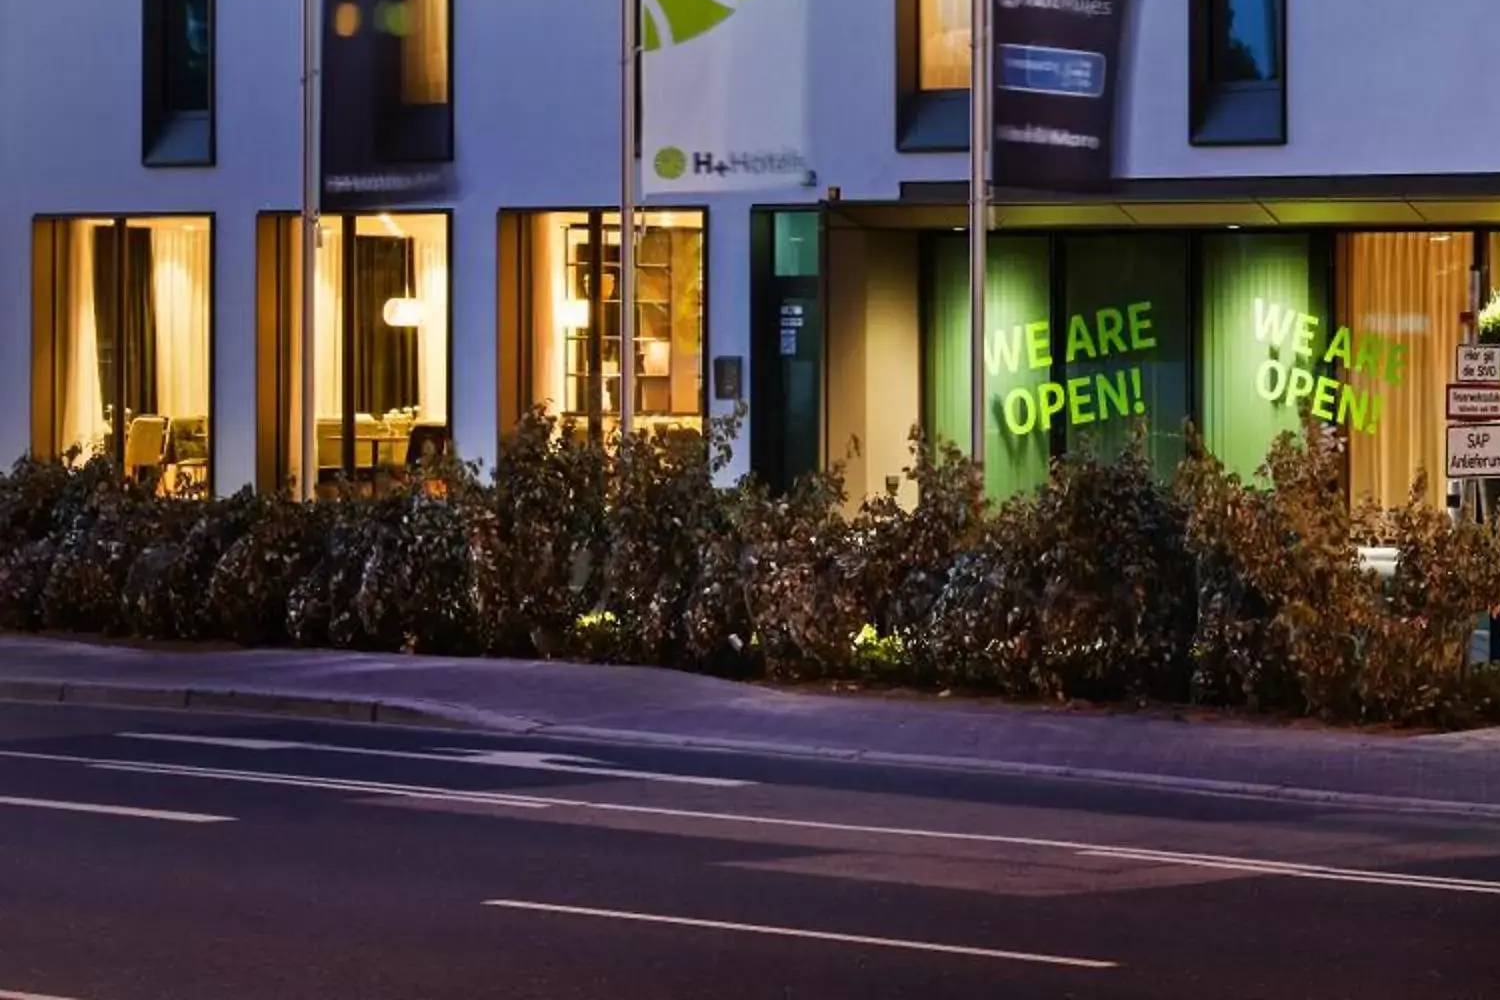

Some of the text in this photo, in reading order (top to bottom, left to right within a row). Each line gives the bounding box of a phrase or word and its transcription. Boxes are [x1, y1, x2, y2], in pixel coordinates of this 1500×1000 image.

[985, 301, 1157, 376] WE ARE
[1253, 297, 1408, 387] WE ARE
[1003, 367, 1146, 436] OPEN!
[1254, 359, 1383, 435] OPEN!
[1466, 432, 1491, 450] SAP
